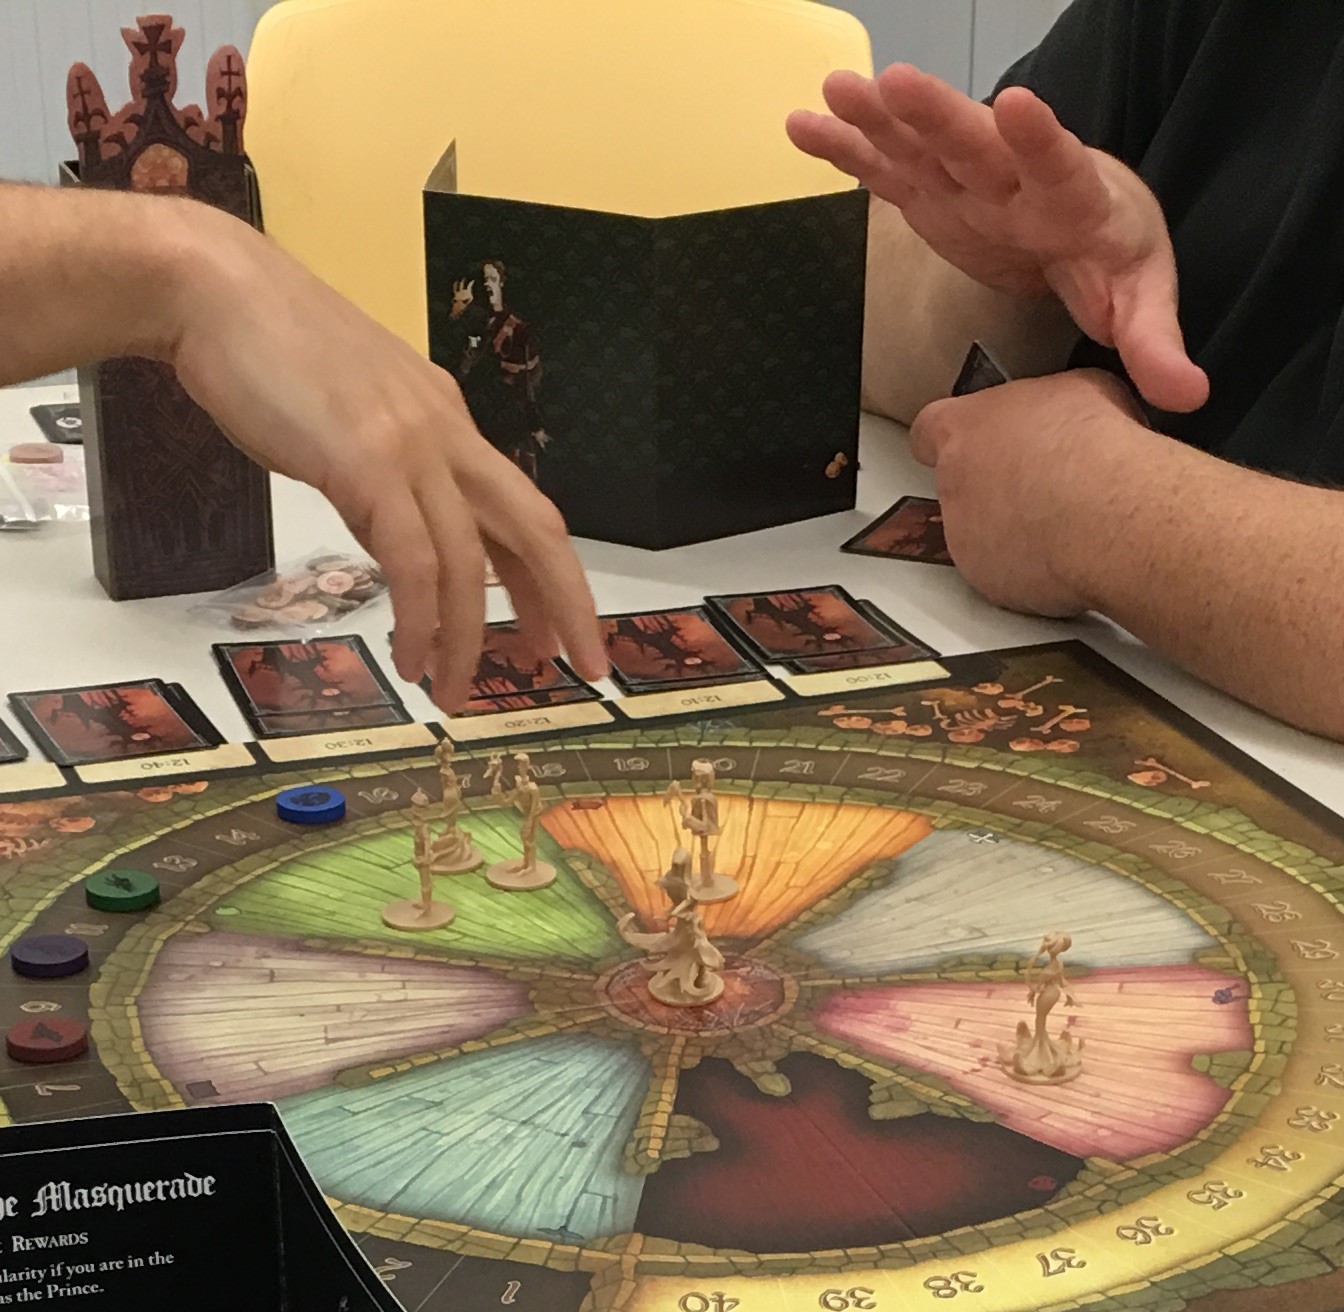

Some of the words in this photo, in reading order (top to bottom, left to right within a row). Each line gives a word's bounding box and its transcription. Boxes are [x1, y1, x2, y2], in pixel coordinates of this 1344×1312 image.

[857, 766, 906, 783] 22
[937, 779, 989, 797] 23
[1290, 938, 1341, 960] 29
[1287, 1105, 1341, 1133] 33
[1246, 1144, 1304, 1174] 34
[31, 1172, 215, 1216] Masquerade
[1186, 1179, 1248, 1211] 35
[11, 1231, 89, 1252] REWARDS
[1115, 1215, 1177, 1246] 36
[49, 1260, 65, 1277] if
[65, 1262, 95, 1280] you
[98, 1259, 124, 1272] are
[126, 1254, 144, 1268] in
[147, 1250, 174, 1266] the
[1035, 1246, 1088, 1278] 37
[15, 1286, 43, 1302] the
[45, 1283, 104, 1299] Prince.
[817, 1285, 879, 1312] 39
[923, 1270, 985, 1300] 38
